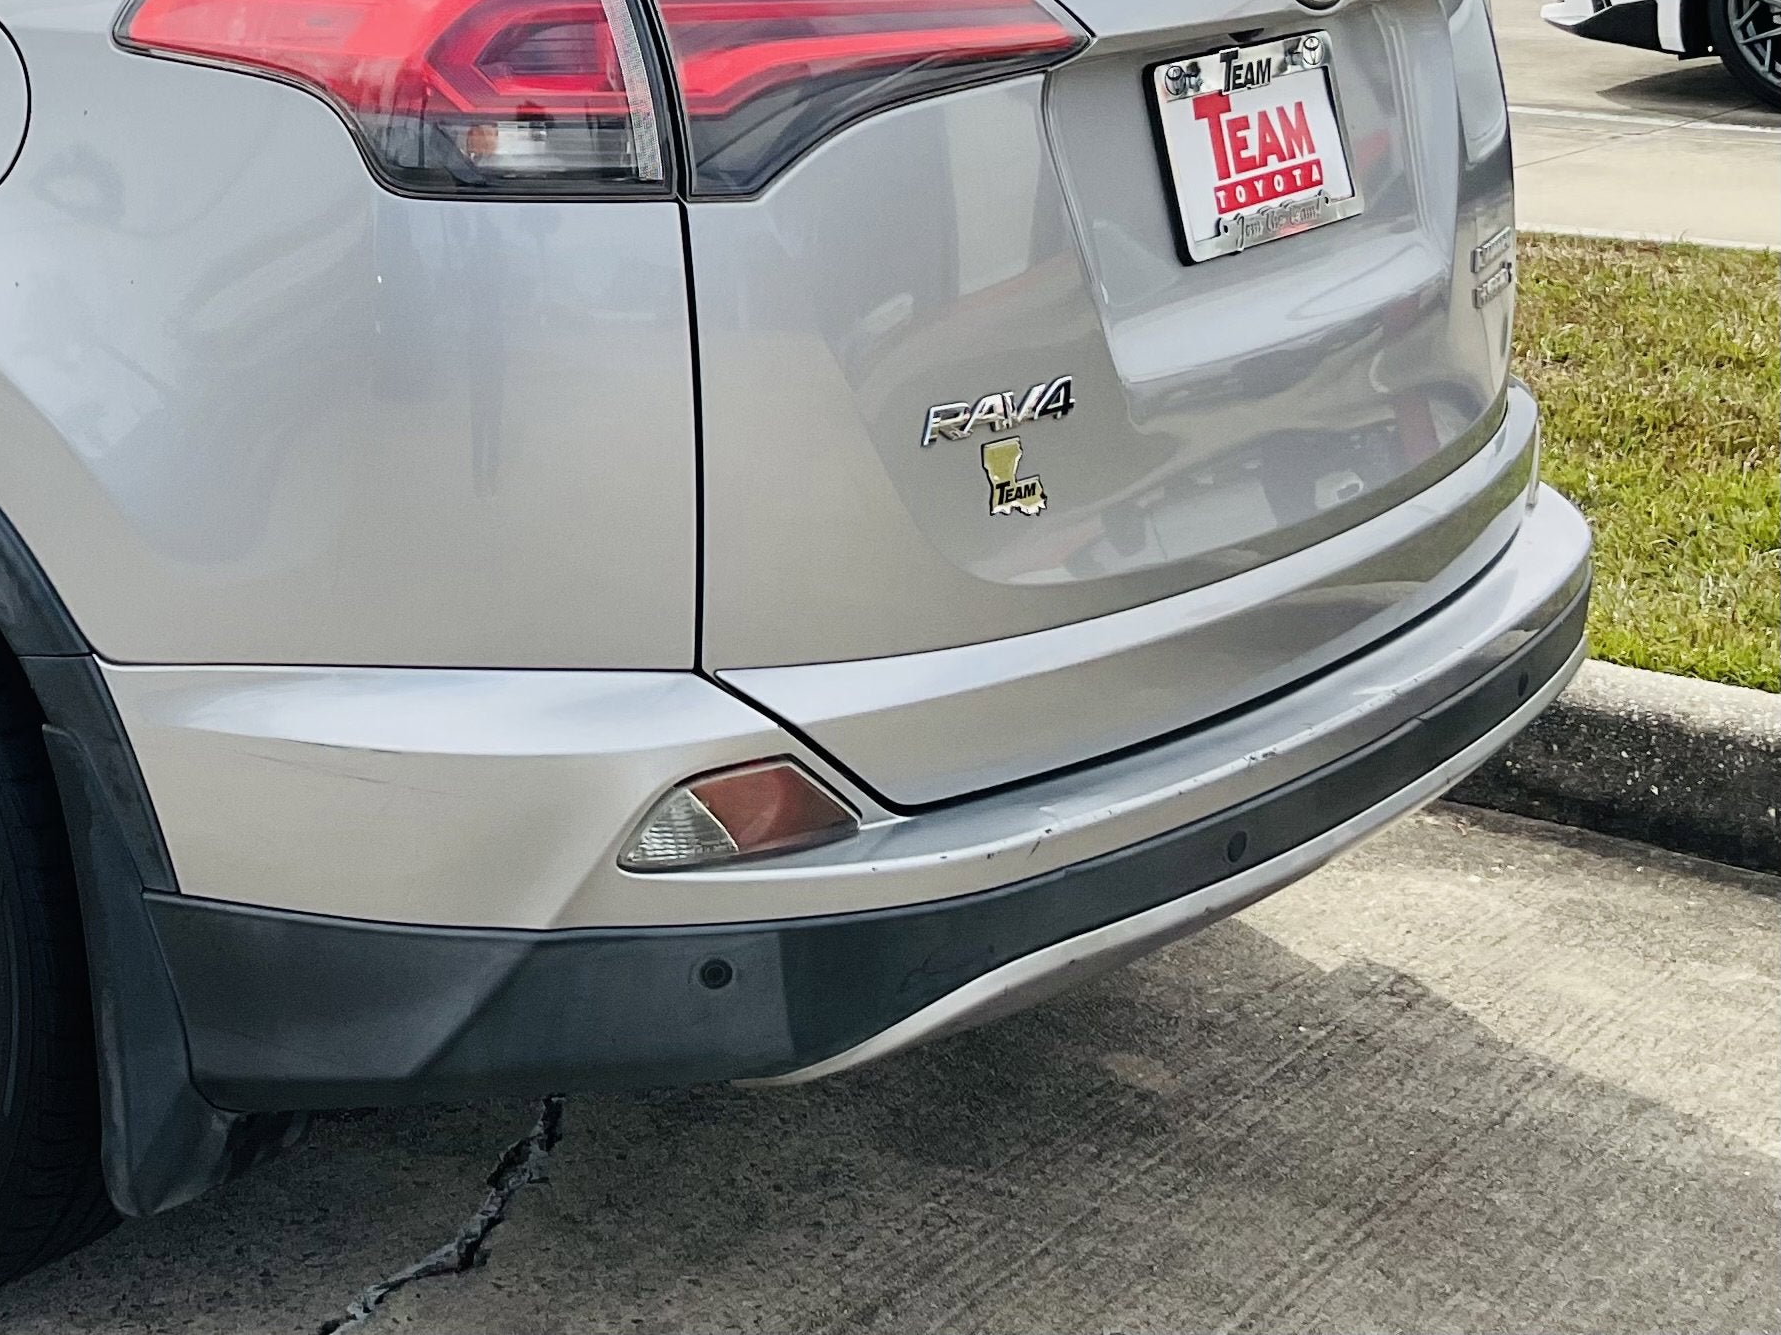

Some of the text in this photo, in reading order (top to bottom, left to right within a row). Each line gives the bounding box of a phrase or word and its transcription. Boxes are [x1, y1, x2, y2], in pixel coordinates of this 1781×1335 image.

[1220, 49, 1271, 93] TEAM
[1191, 91, 1317, 181] TEAM
[1216, 163, 1321, 209] TOYOTA
[921, 375, 1075, 447] RAV4
[995, 480, 1037, 506] TEAM
